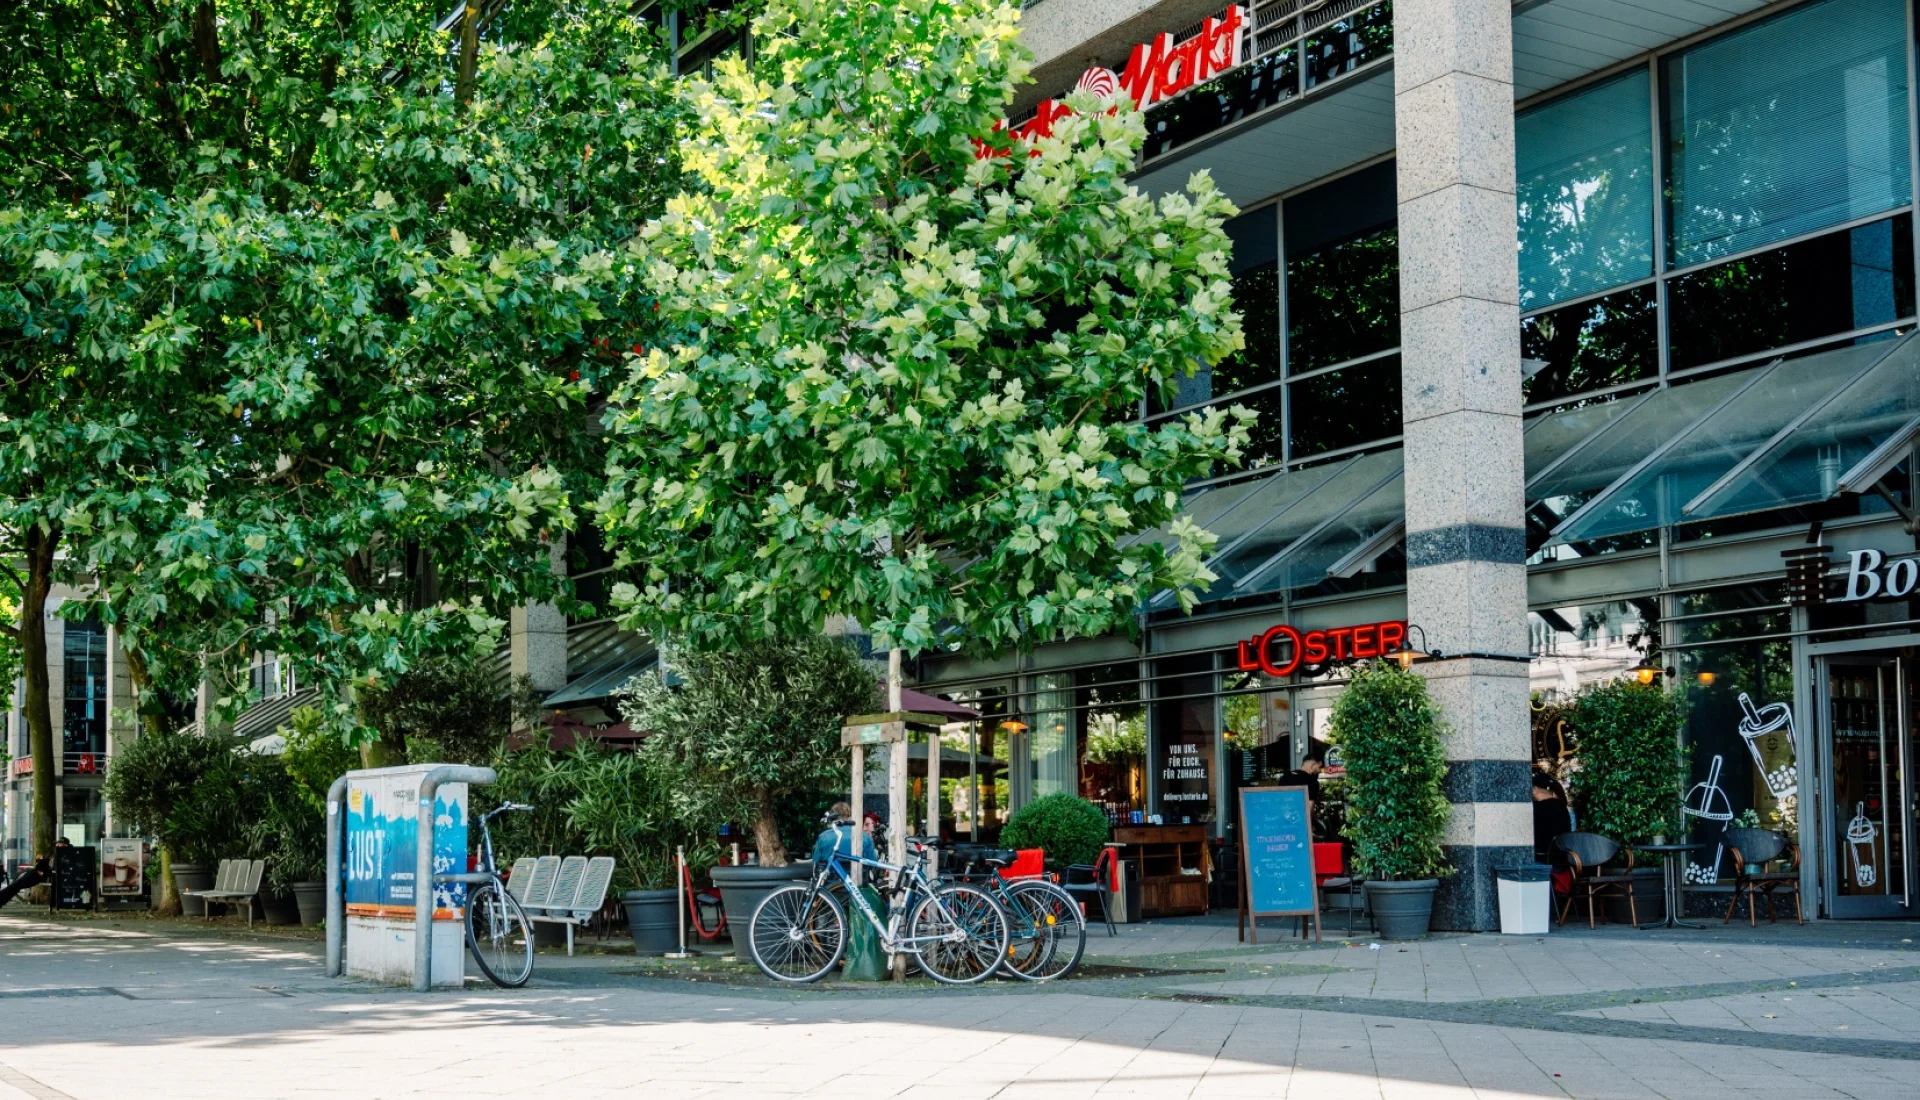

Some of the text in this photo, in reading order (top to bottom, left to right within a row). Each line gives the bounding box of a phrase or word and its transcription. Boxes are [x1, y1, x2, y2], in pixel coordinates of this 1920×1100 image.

[1110, 4, 1249, 112] Markt
[1238, 621, 1408, 677] L'OSTER
[1169, 744, 1198, 755] VON UNS.
[1168, 756, 1202, 768] FÜR EUCH.
[1163, 767, 1208, 780] FÜR ZUHAUSE.
